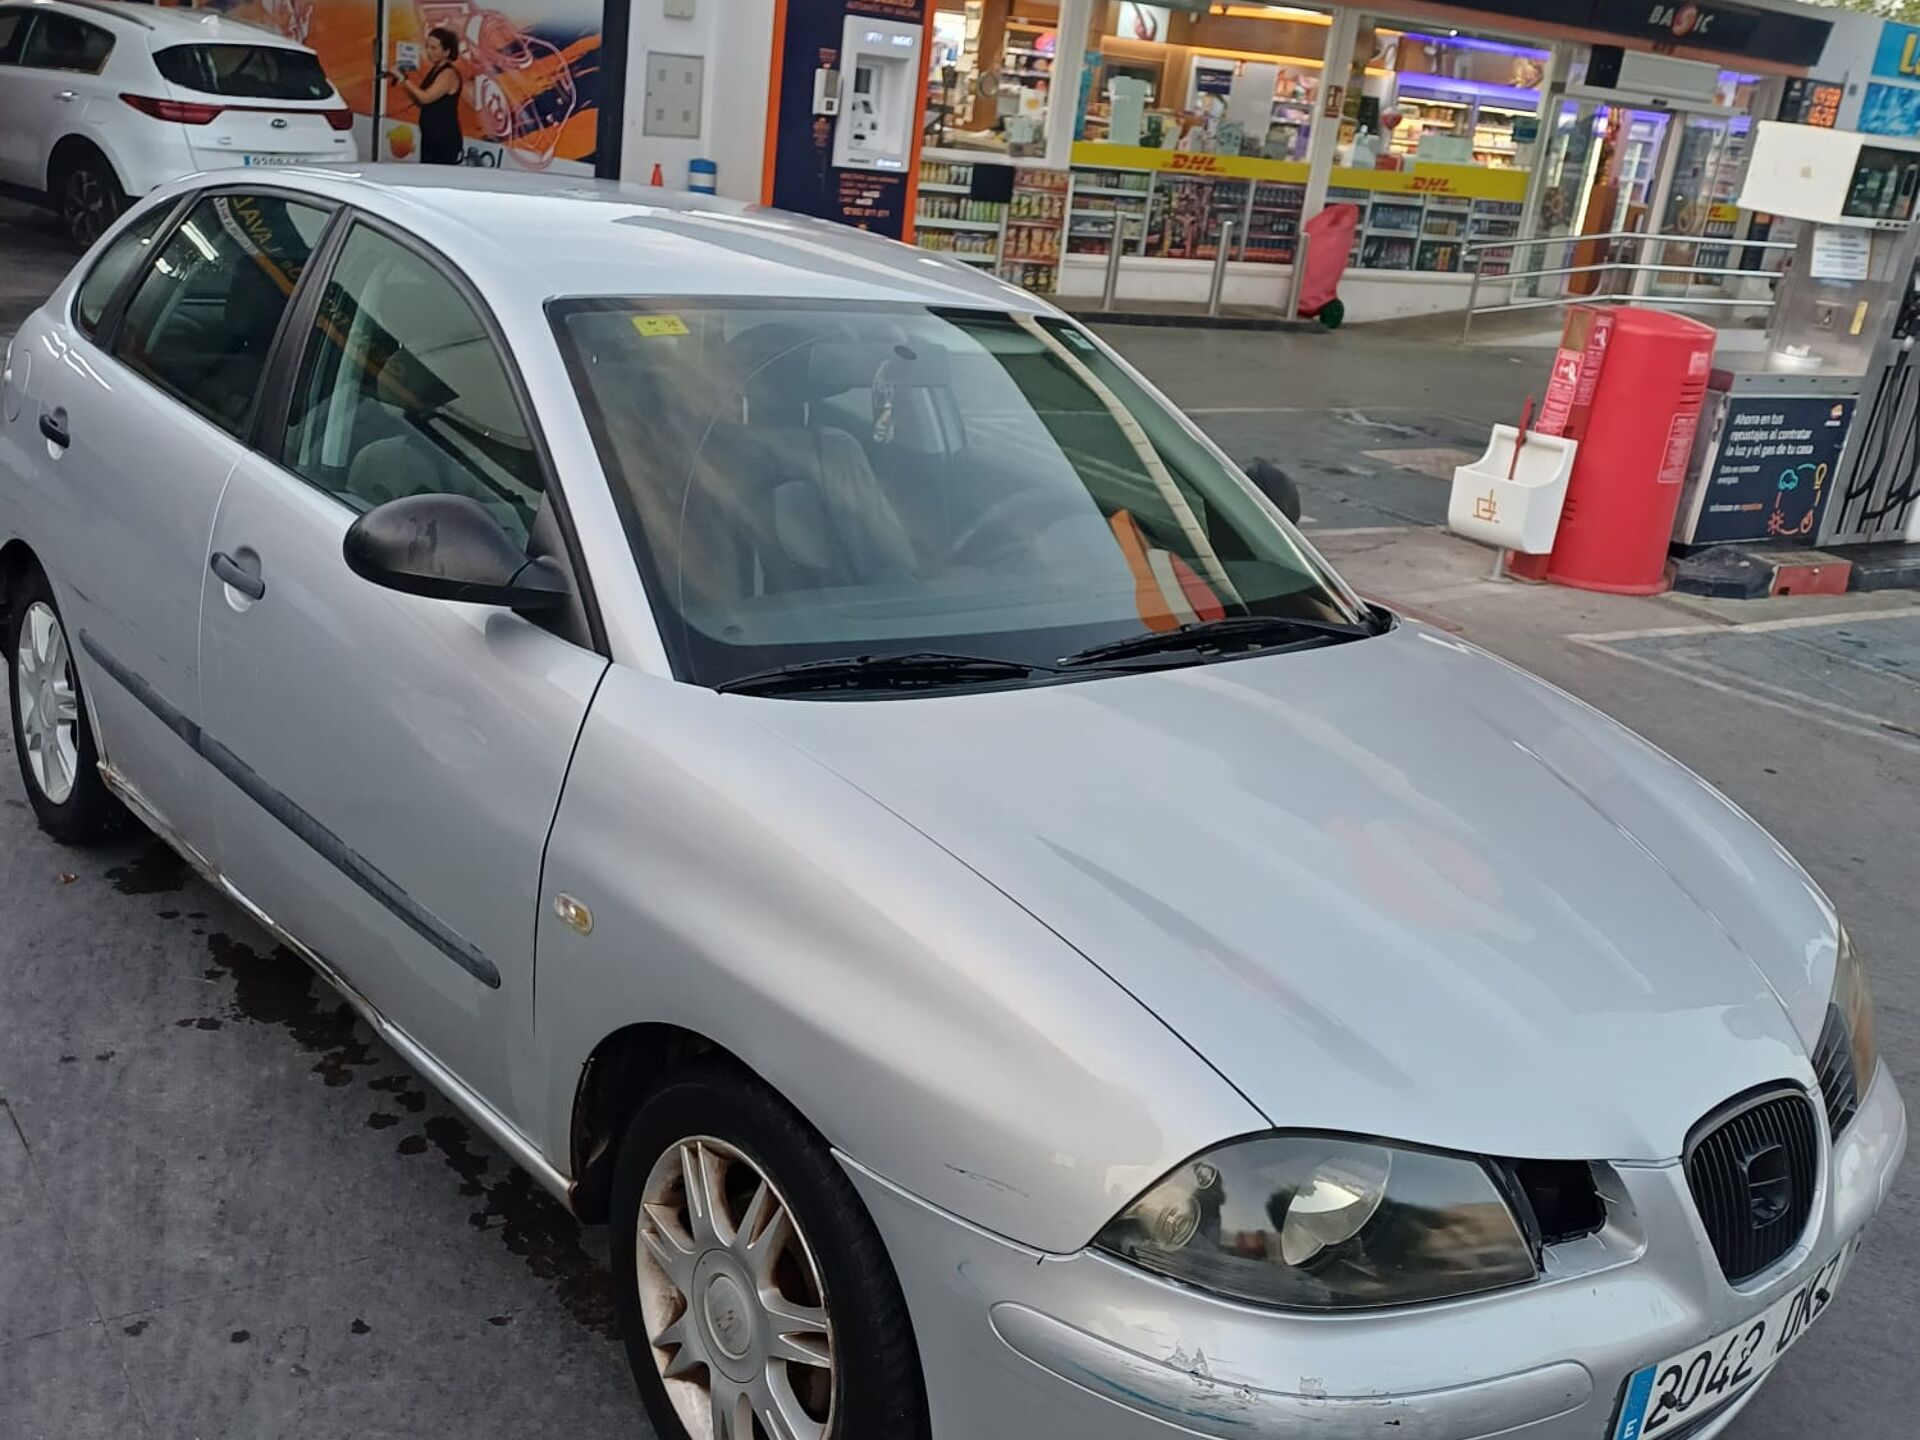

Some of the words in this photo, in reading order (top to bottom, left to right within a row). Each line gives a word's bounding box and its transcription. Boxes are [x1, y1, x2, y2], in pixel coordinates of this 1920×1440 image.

[1899, 33, 1920, 74] L
[1169, 153, 1218, 172] DHL
[1411, 176, 1450, 193] DHL
[1734, 414, 1760, 425] Ahorra
[1643, 1320, 1766, 1434] 2042
[1623, 1417, 1638, 1439] E
